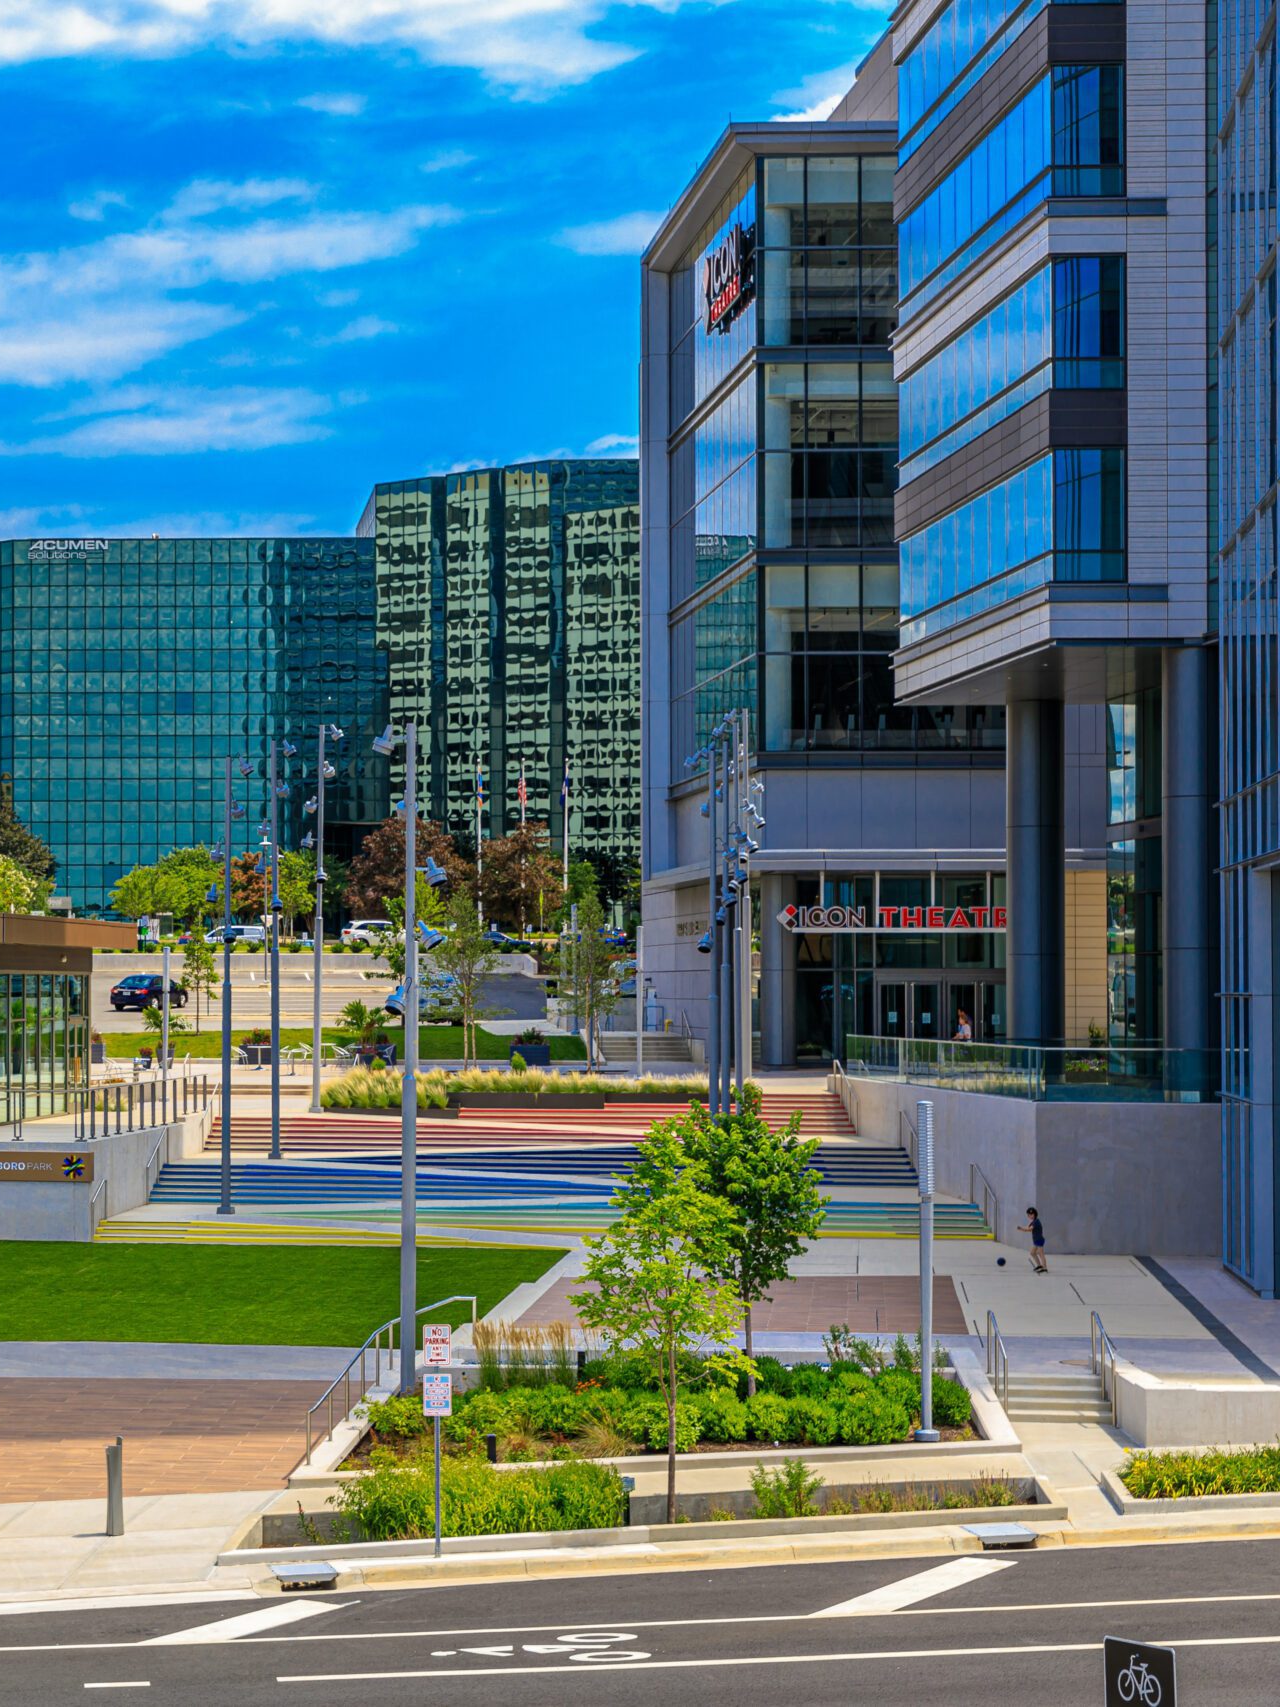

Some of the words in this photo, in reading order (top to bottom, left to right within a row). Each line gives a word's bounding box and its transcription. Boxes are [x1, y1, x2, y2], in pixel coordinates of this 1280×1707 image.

[710, 224, 739, 302] ICON
[29, 540, 109, 550] ACUMEN
[28, 551, 87, 559] solutions
[799, 906, 866, 928] ICON
[26, 1162, 53, 1171] PARK
[425, 1337, 449, 1345] PARKING
